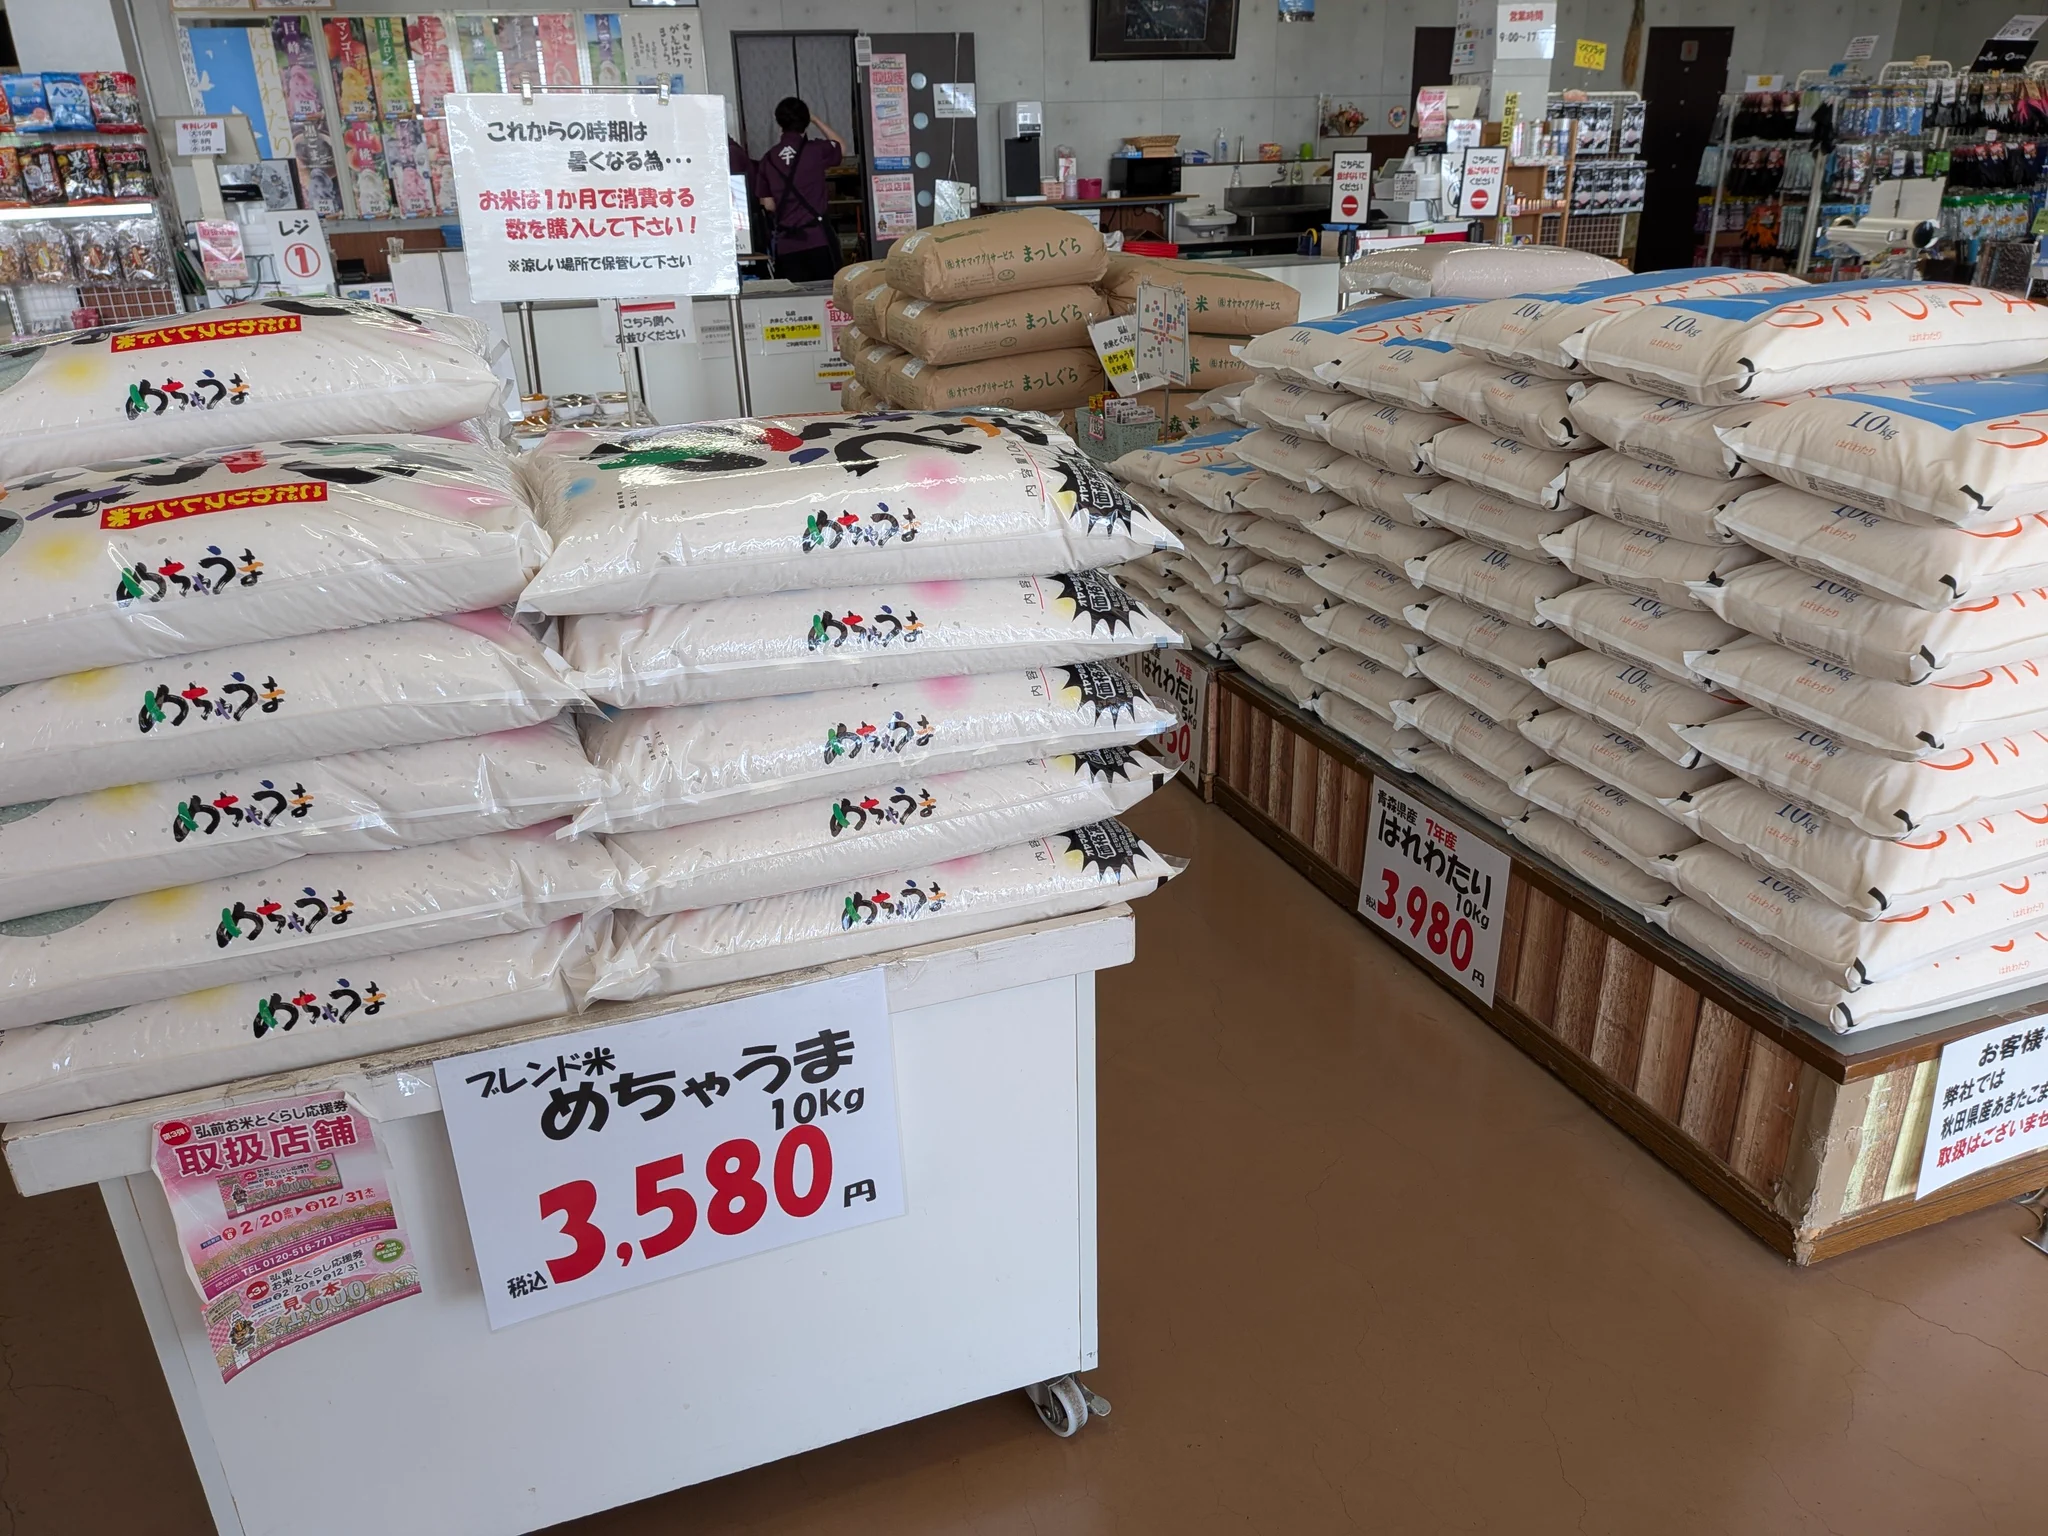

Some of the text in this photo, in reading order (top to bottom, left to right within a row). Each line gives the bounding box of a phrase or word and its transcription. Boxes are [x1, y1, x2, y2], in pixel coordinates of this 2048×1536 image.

[1508, 10, 1544, 22] 営業時間
[282, 20, 300, 55] 巨峰
[335, 21, 352, 63] マンゴー
[486, 120, 648, 143] これからの時期は
[478, 187, 695, 211] お米は1か月で消費する
[278, 219, 310, 237] レジ
[504, 216, 697, 240] 数を購入して下さい！
[507, 254, 693, 273] ※涼しい場所で保管して下さい
[1023, 237, 1082, 263] まっしぐら
[622, 315, 674, 329] こちら側へ
[1025, 303, 1084, 331] まっしぐら
[1512, 301, 1544, 321] 10kg
[1661, 314, 1703, 339] 10kg
[115, 315, 299, 350] こだわりブレンド米
[124, 368, 252, 422] めちゃうま
[1022, 366, 1079, 393] まっしぐら
[1846, 409, 1901, 441] 10kg
[106, 483, 324, 528] こだわりブレンド米
[800, 501, 924, 555] めちゃうま
[114, 544, 265, 608] めちゃうま
[806, 604, 926, 653] めちゃうま
[1174, 658, 1194, 683] 7年産
[1615, 664, 1653, 694] 10kg
[138, 671, 287, 734] めちゃうま
[1181, 706, 1198, 731] 5kg
[823, 711, 936, 766] めちゃうま
[172, 779, 316, 844] めちゃうま
[829, 785, 939, 838] めちゃうま
[1376, 788, 1459, 852] 青森県産 7年産
[1376, 808, 1493, 912] はれわたり
[215, 886, 356, 949] めちゃうま
[841, 879, 947, 932] めちゃうま
[1454, 893, 1491, 931] 10kg
[1376, 867, 1474, 973] 3,980
[1471, 967, 1485, 989] 円
[252, 976, 387, 1039] めちゃうま
[1977, 1026, 2048, 1068] お客様
[465, 1046, 617, 1099] ブレンド米
[539, 1028, 857, 1142] めちゃうま
[1941, 1067, 2006, 1111] 弊社では
[193, 1099, 349, 1140] 弘前お米とくらし応援券
[770, 1086, 866, 1132] 10kg
[174, 1115, 357, 1177] 取扱店舗
[240, 1210, 283, 1236] 2/20
[318, 1189, 365, 1210] 12/31
[506, 1123, 878, 1299] 税込 3,580 円
[241, 1262, 262, 1277] TEL
[262, 1235, 334, 1269] 0120-516-771
[269, 1268, 293, 1282] 弘前
[271, 1249, 364, 1292] お米とくらし応援券
